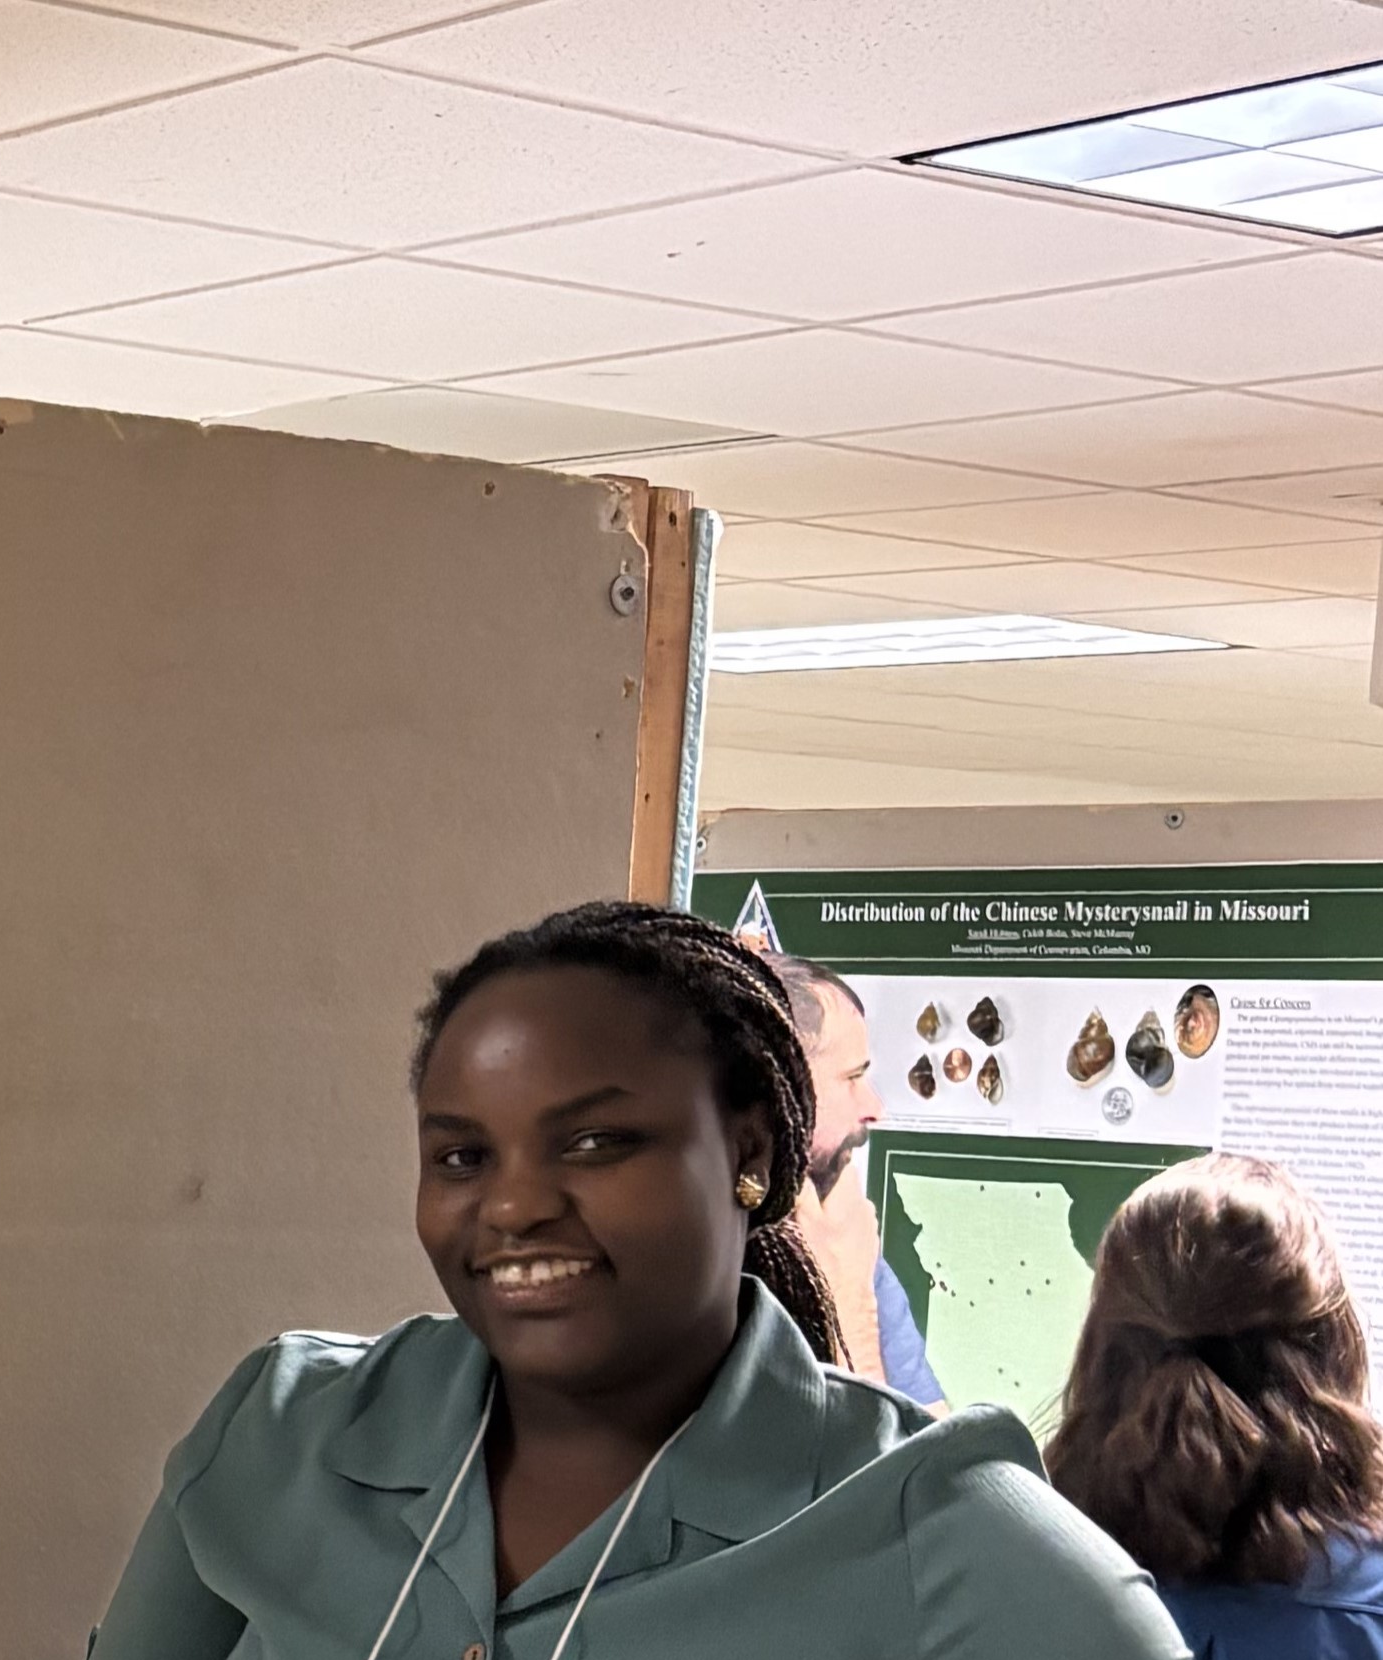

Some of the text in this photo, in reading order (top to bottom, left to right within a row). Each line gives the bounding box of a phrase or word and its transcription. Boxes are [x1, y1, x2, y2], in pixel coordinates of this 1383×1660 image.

[820, 898, 1310, 927] Distribution of the Chinese Mysterysnail in Missouri
